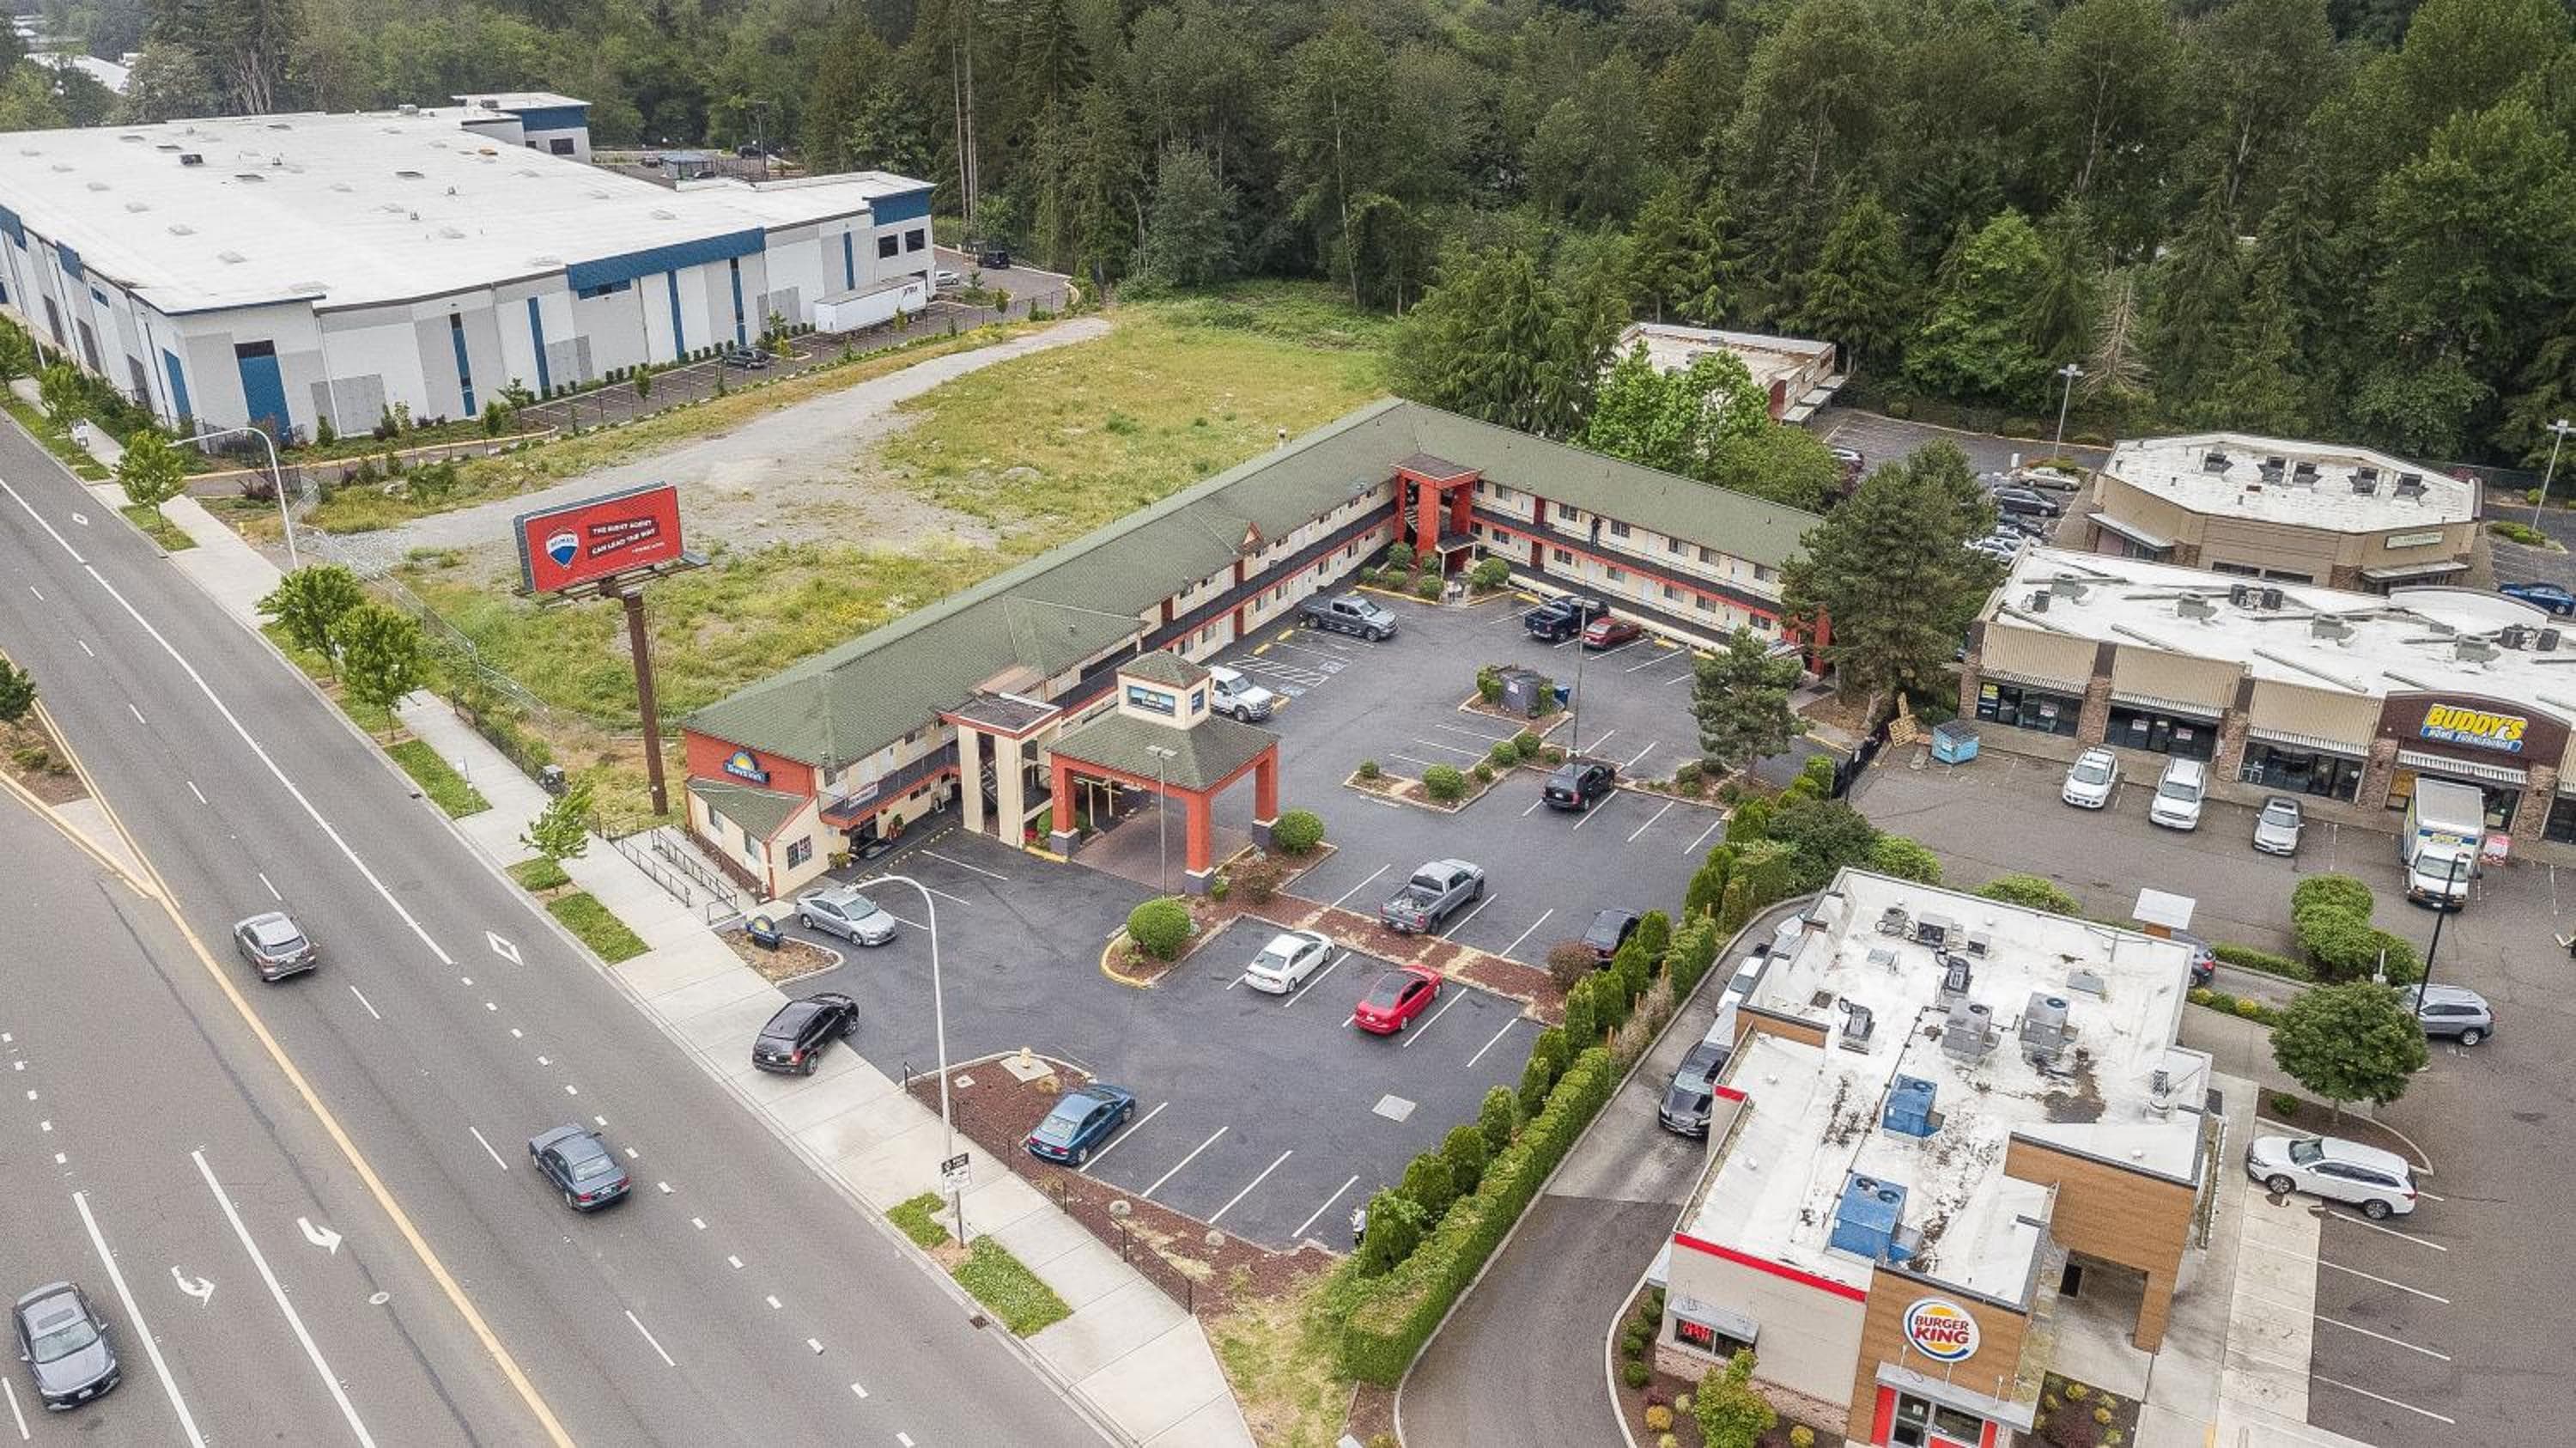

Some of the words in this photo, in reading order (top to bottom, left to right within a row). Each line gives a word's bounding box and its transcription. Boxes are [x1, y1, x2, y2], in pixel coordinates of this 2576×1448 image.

[592, 545, 607, 554] CAN
[607, 538, 626, 549] LEAD
[640, 528, 655, 538] WAY
[2425, 708, 2527, 740] BUDDY'S
[1915, 1315, 1969, 1331] BURGER
[1914, 1327, 1970, 1344] KING
